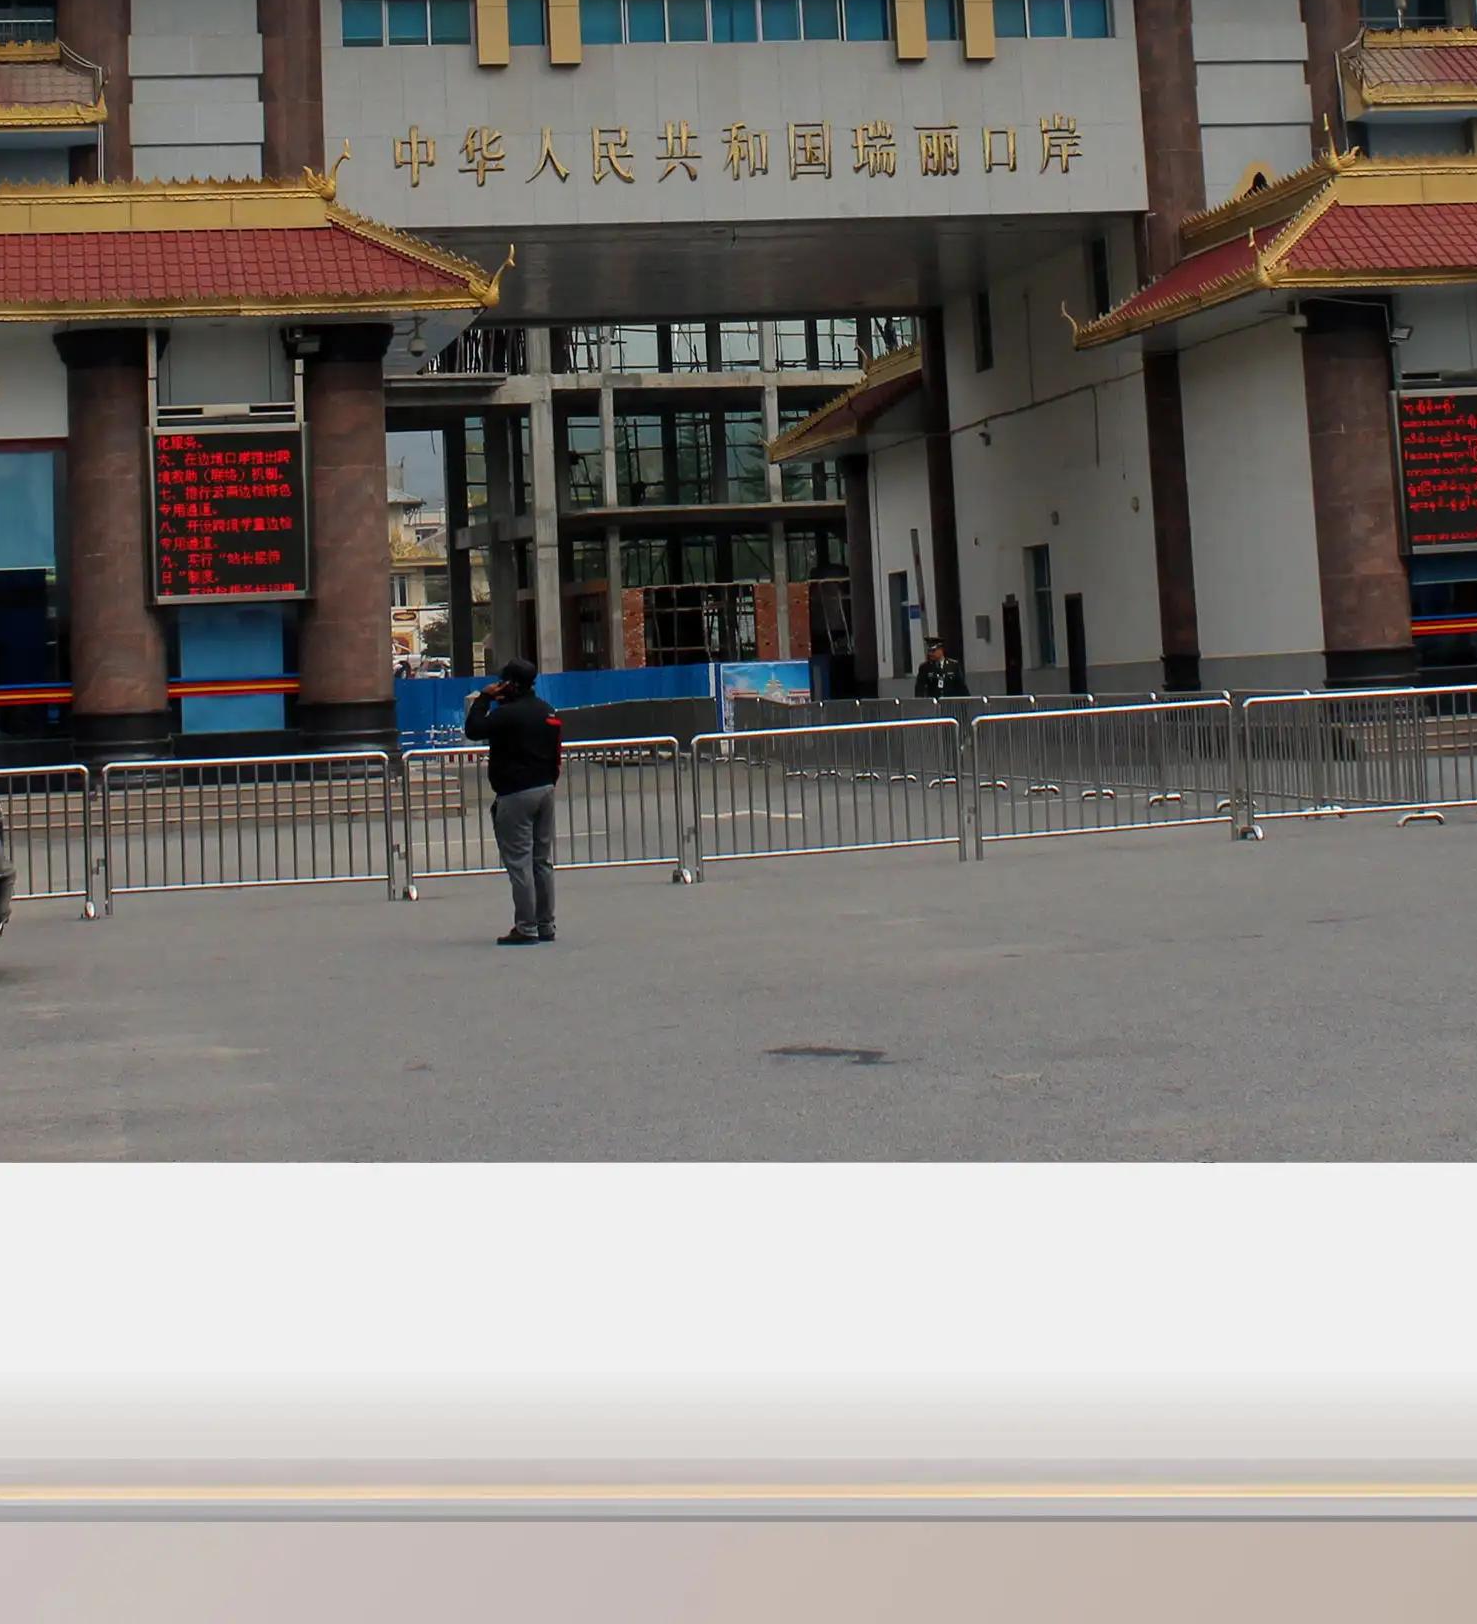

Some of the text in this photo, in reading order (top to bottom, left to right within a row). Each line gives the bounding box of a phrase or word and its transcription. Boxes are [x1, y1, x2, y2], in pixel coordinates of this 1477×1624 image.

[392, 112, 1083, 188] 中华人民共和国瑞丽口岸
